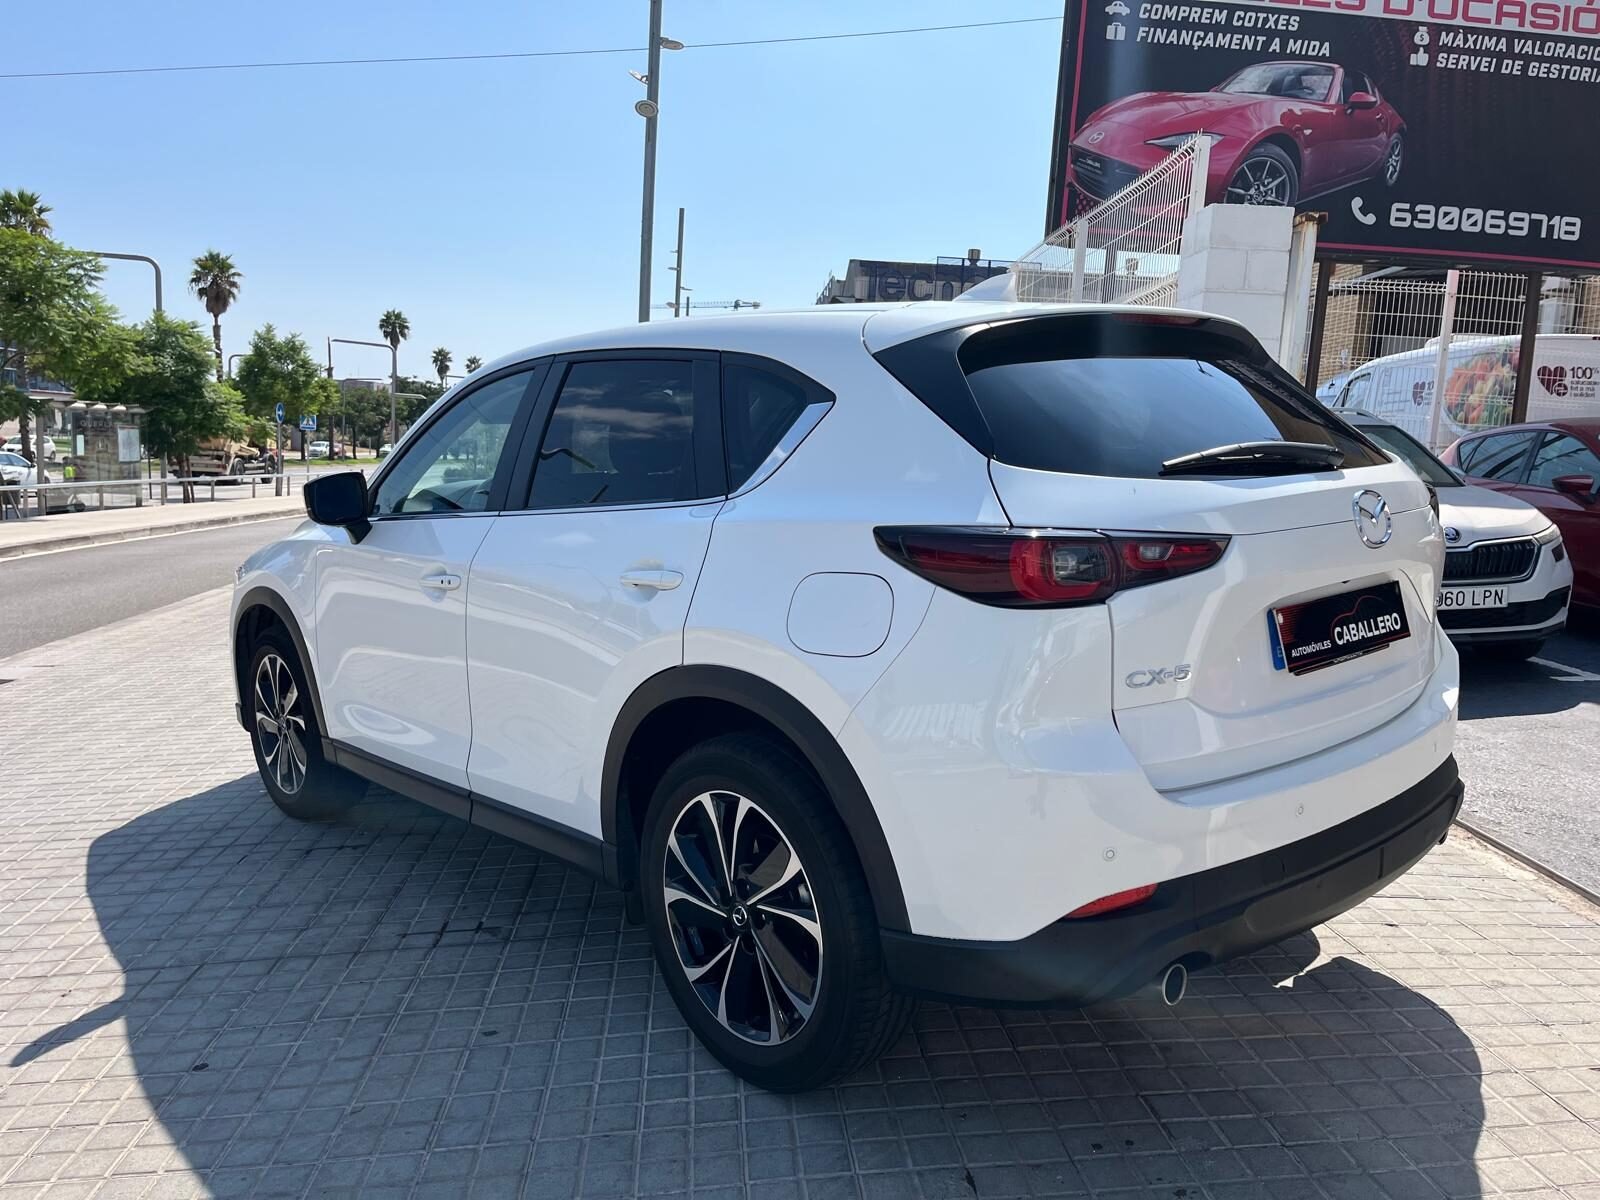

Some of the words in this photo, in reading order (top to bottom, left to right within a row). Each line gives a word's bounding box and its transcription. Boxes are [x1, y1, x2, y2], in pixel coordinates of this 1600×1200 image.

[1138, 3, 1228, 24] COMPREM
[1232, 10, 1300, 31] COTXES
[1383, 0, 1600, 34] DOCASIÓ
[1136, 26, 1266, 51] FINANÇAMENT
[1268, 37, 1281, 53] A
[1286, 39, 1330, 57] MIDA
[1438, 29, 1507, 52] MÀXIMA
[1436, 52, 1497, 72] SERVEI
[1501, 59, 1524, 75] DE
[1389, 202, 1582, 241] 630069718
[1471, 589, 1504, 606] LPN
[1291, 640, 1332, 657] AUTOMÓVILES
[1334, 612, 1401, 645] CABALLERO
[1125, 664, 1192, 688] CX-5
